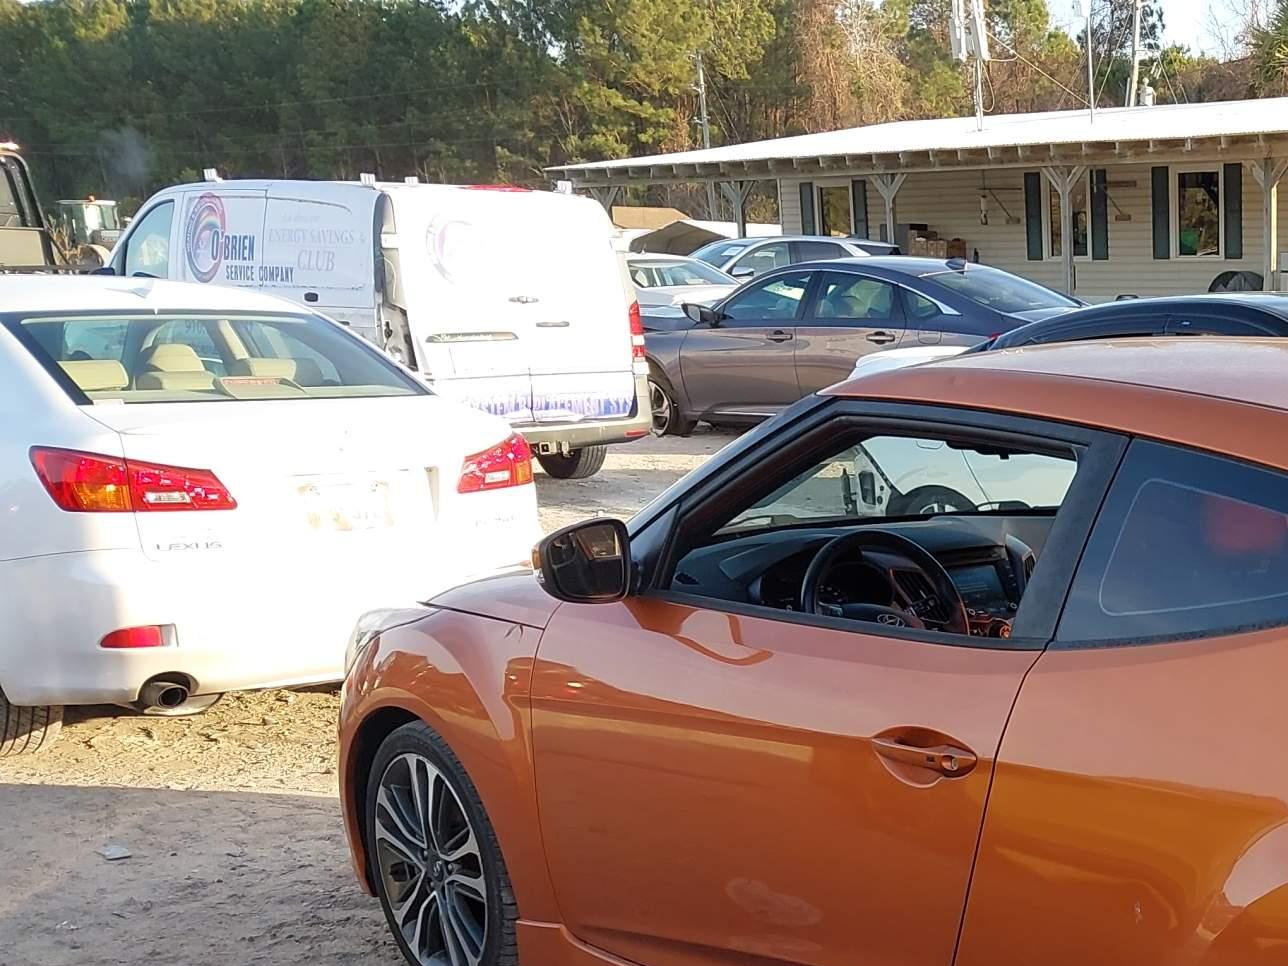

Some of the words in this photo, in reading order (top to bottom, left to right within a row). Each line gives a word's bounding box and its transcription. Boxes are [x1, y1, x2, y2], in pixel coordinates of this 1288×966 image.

[211, 229, 256, 261] O'BRIEN
[268, 228, 309, 244] ENERGY
[310, 229, 354, 246] SAVINGS
[297, 249, 335, 271] CLUB
[225, 264, 255, 281] SERVICE
[258, 265, 294, 283] COMPANY
[155, 541, 222, 552] LEXUS
